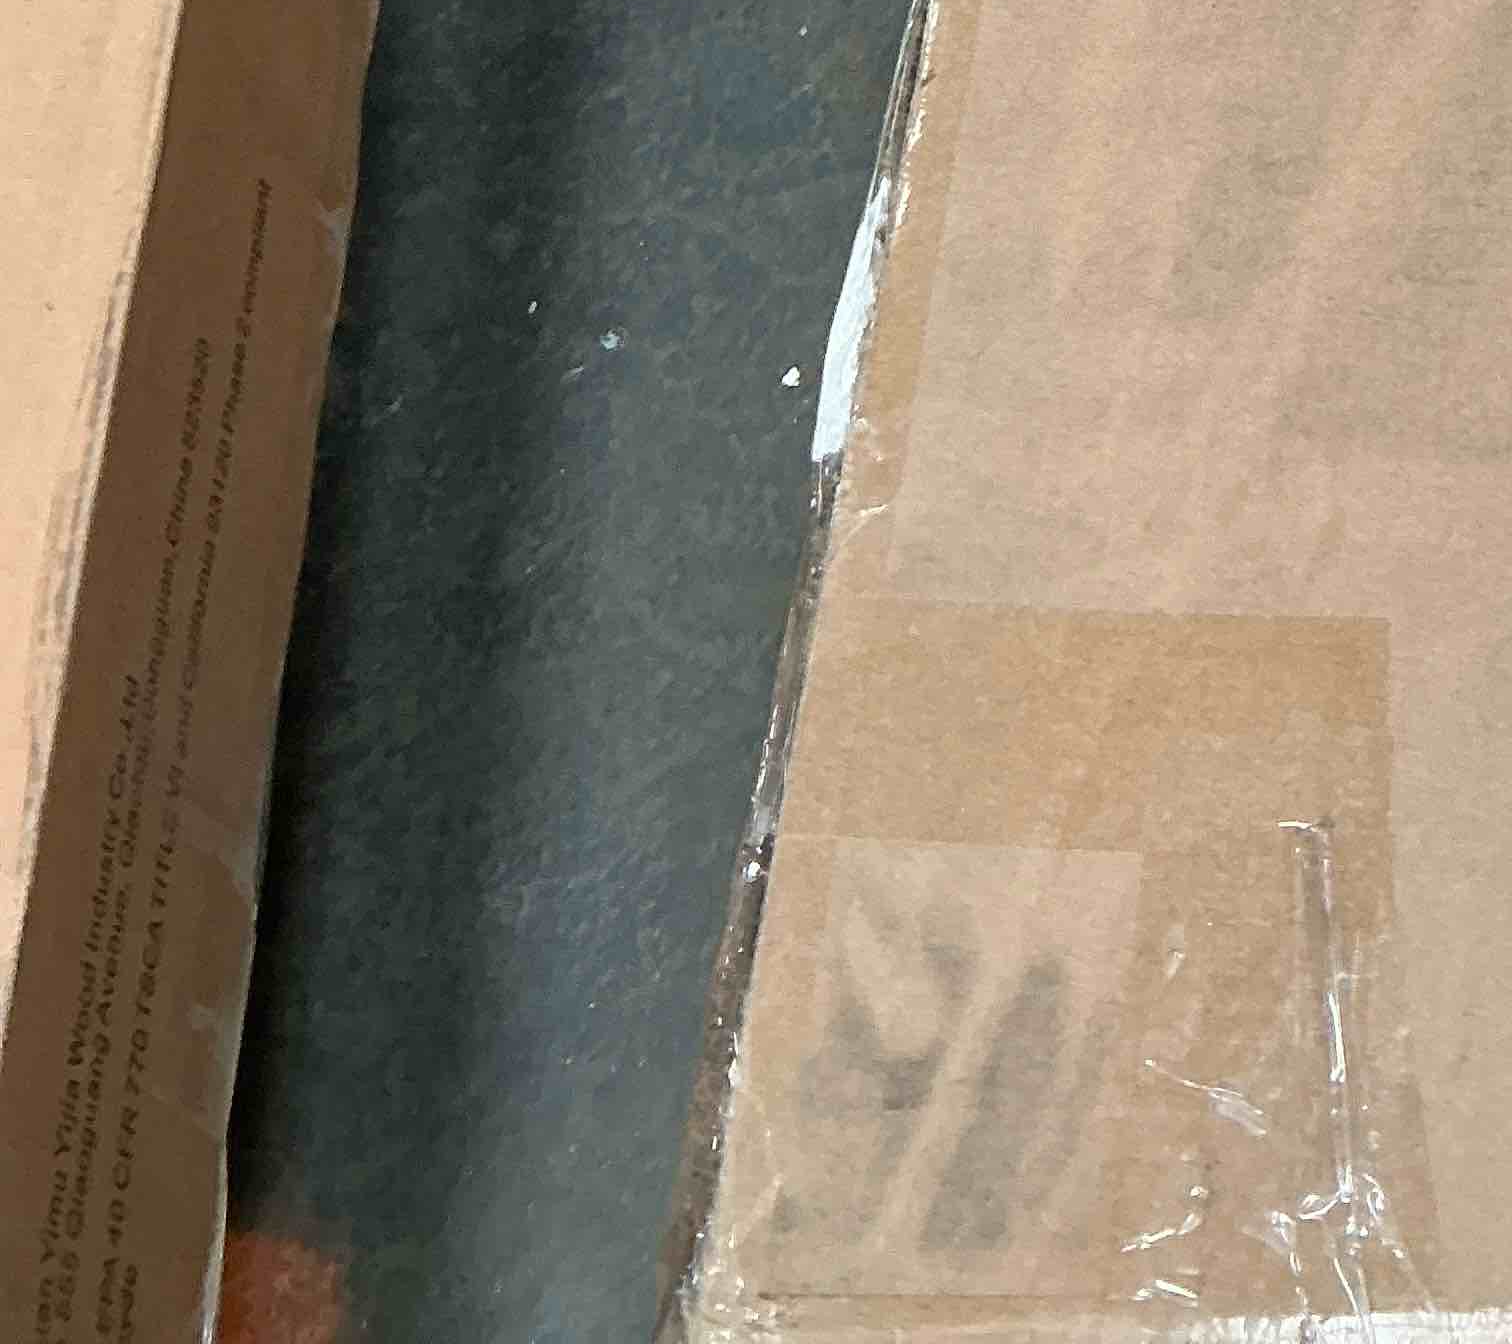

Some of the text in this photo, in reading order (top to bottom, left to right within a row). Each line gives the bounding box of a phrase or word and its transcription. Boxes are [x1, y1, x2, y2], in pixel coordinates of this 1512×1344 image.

[69, 963, 95, 1067] Wood
[87, 810, 119, 953] Industry
[126, 1028, 149, 1096] 770
[138, 920, 163, 1019] TSCA
